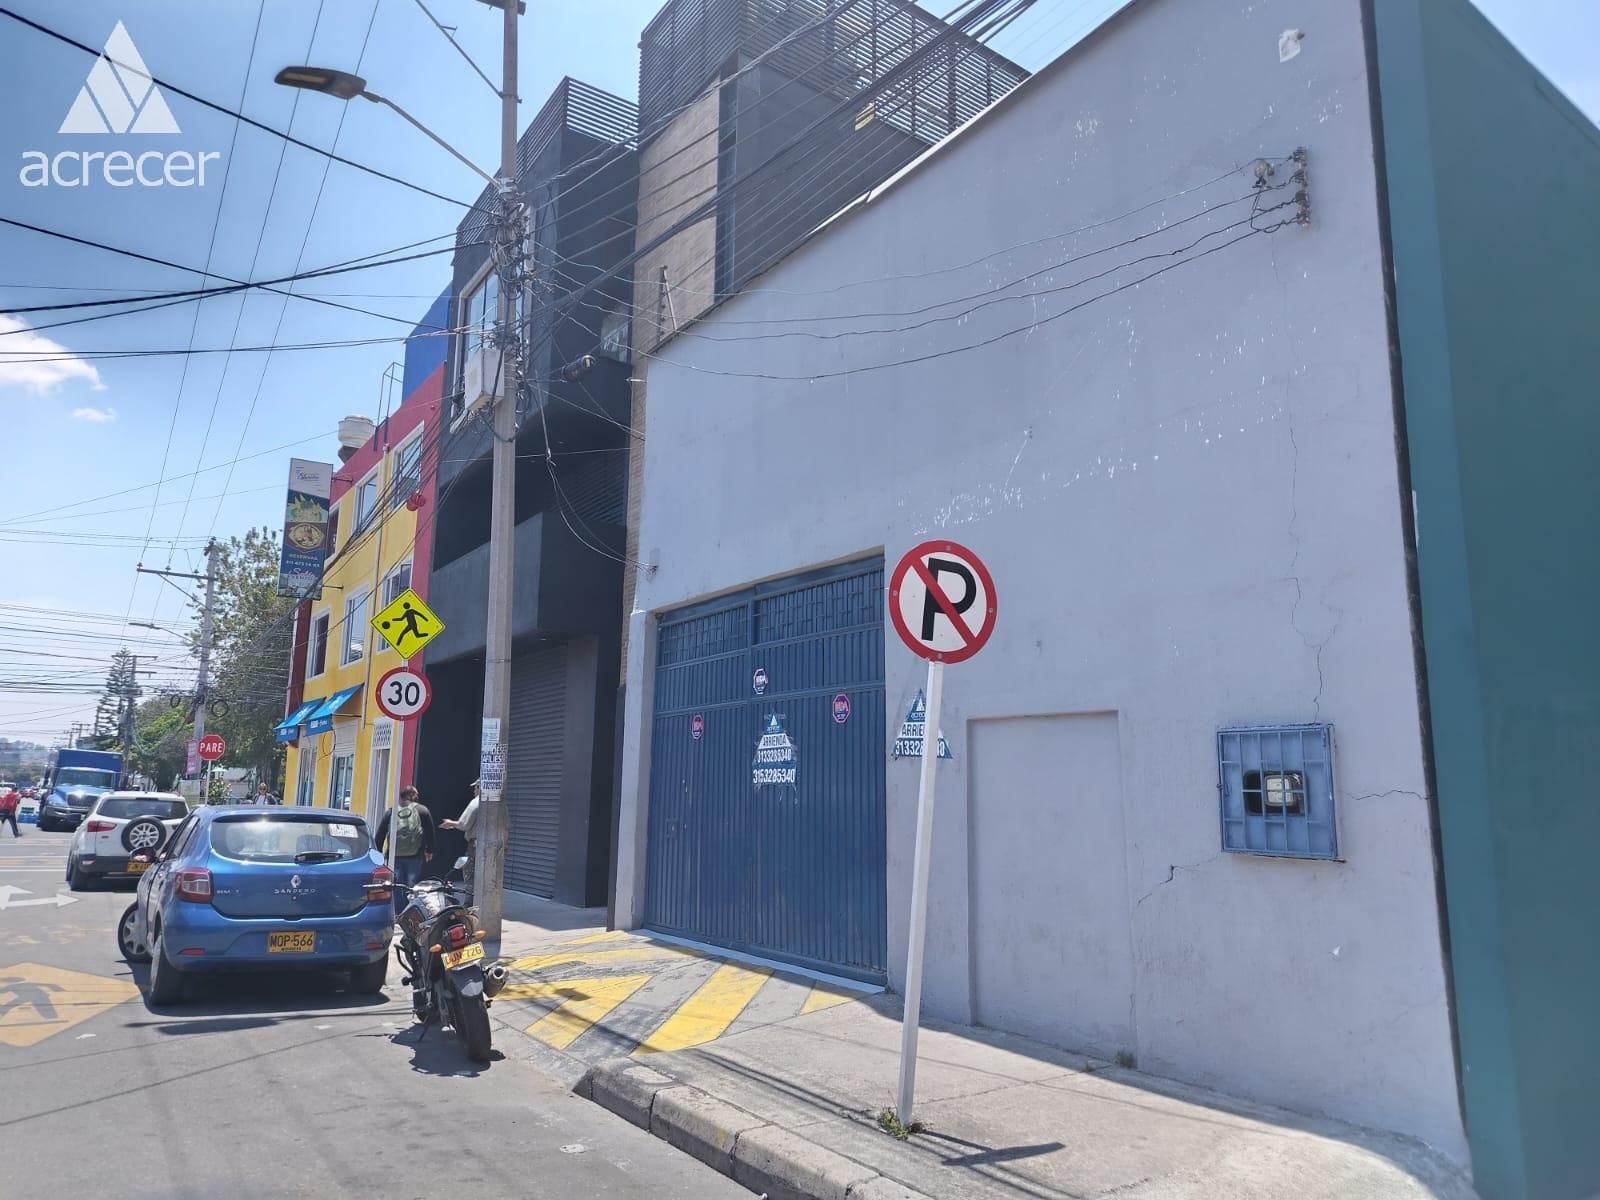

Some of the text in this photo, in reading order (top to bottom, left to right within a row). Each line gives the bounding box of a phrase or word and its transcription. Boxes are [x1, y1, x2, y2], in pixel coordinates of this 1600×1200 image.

[921, 557, 977, 641] P
[388, 681, 420, 706] 30
[199, 742, 224, 753] PARE
[762, 735, 788, 747] ARRIENDA
[895, 740, 945, 757] 313320
[753, 768, 796, 783] 3153285340
